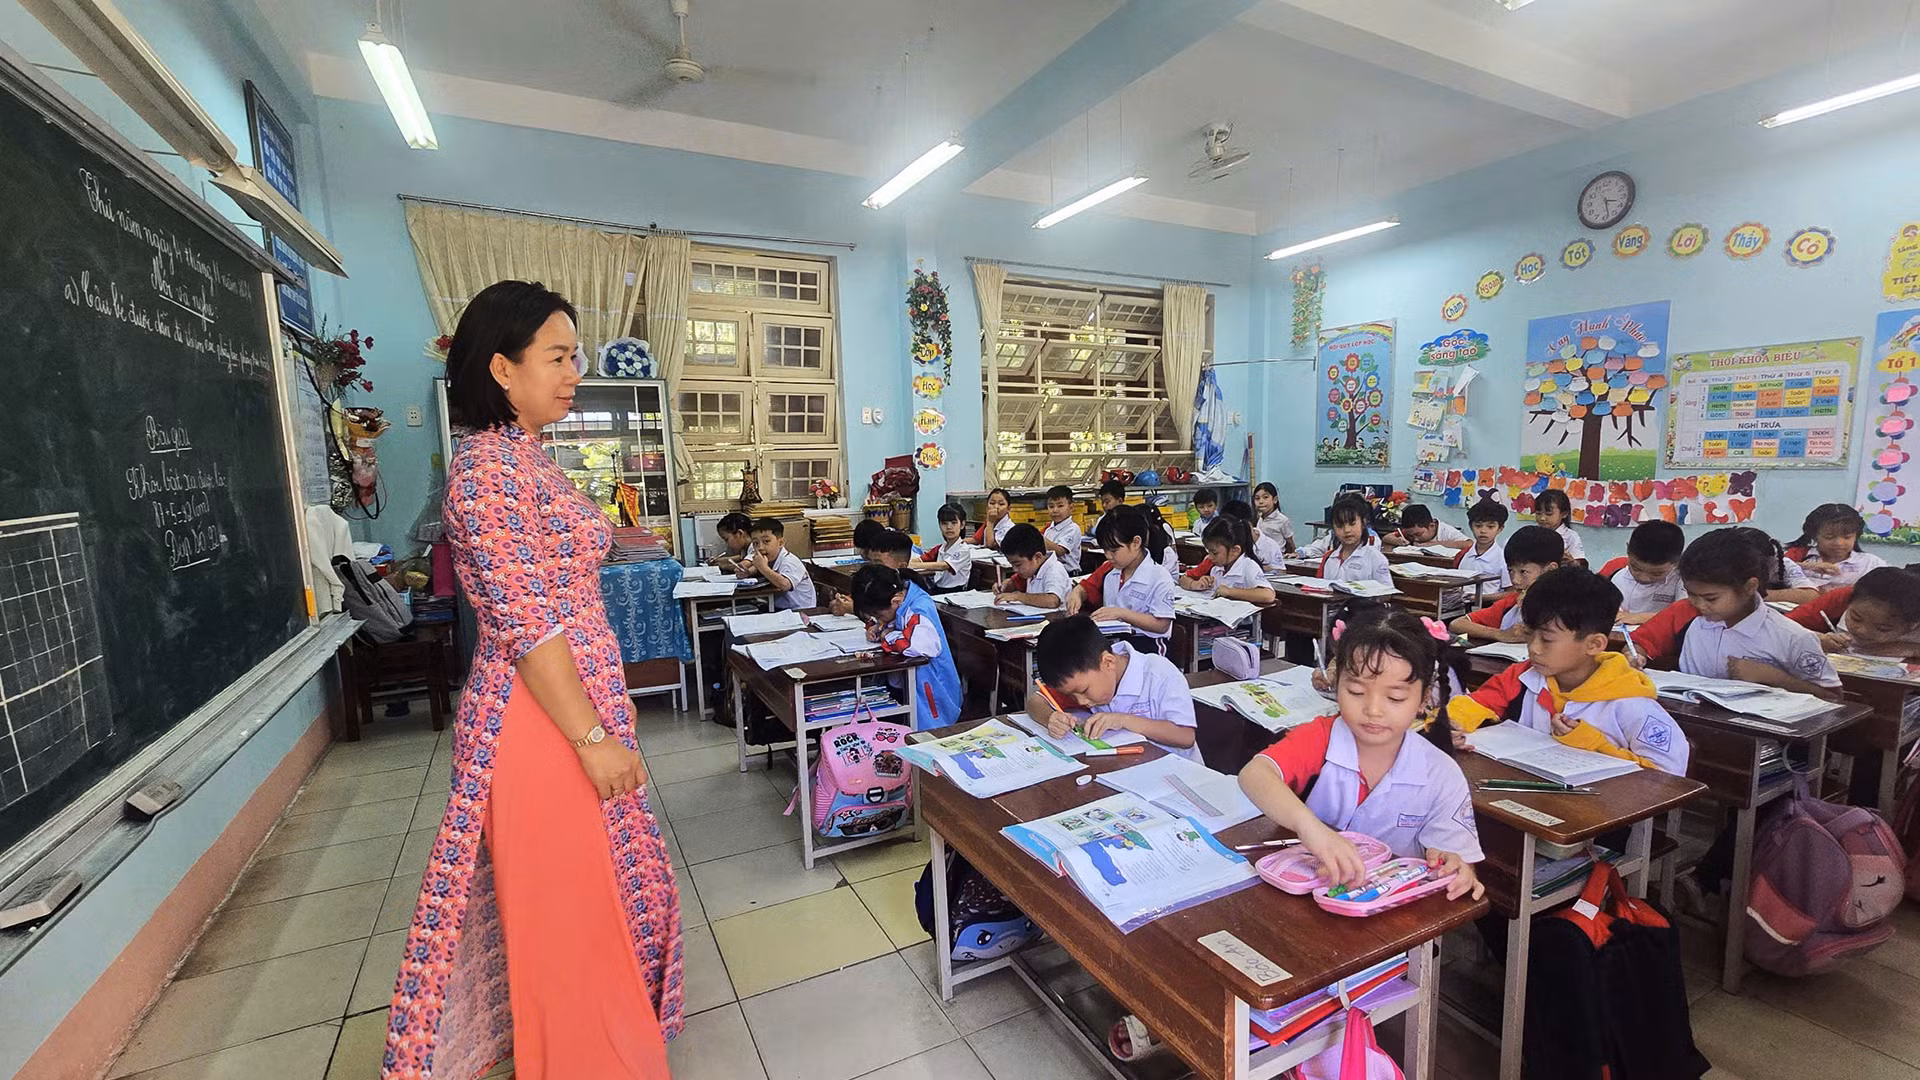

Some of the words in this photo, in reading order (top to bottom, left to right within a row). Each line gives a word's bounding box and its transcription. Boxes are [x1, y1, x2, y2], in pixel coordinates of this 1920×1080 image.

[79, 168, 115, 222] Thứ
[1480, 277, 1500, 294] Ngoan
[1520, 261, 1539, 278] Học
[1567, 246, 1586, 263] Tốt
[1676, 234, 1698, 249] Lời
[1732, 230, 1761, 250] Thầy
[1796, 238, 1821, 255] Cô
[64, 275, 80, 307] a)
[1443, 337, 1465, 348] Góc
[1430, 350, 1455, 360] sáng
[1459, 346, 1477, 358] tạo
[1909, 357, 1916, 367] 1
[922, 380, 936, 393] Học
[1738, 420, 1760, 430] NGHỈ
[1760, 421, 1782, 429] TRƯA
[833, 734, 859, 748] ROCK
